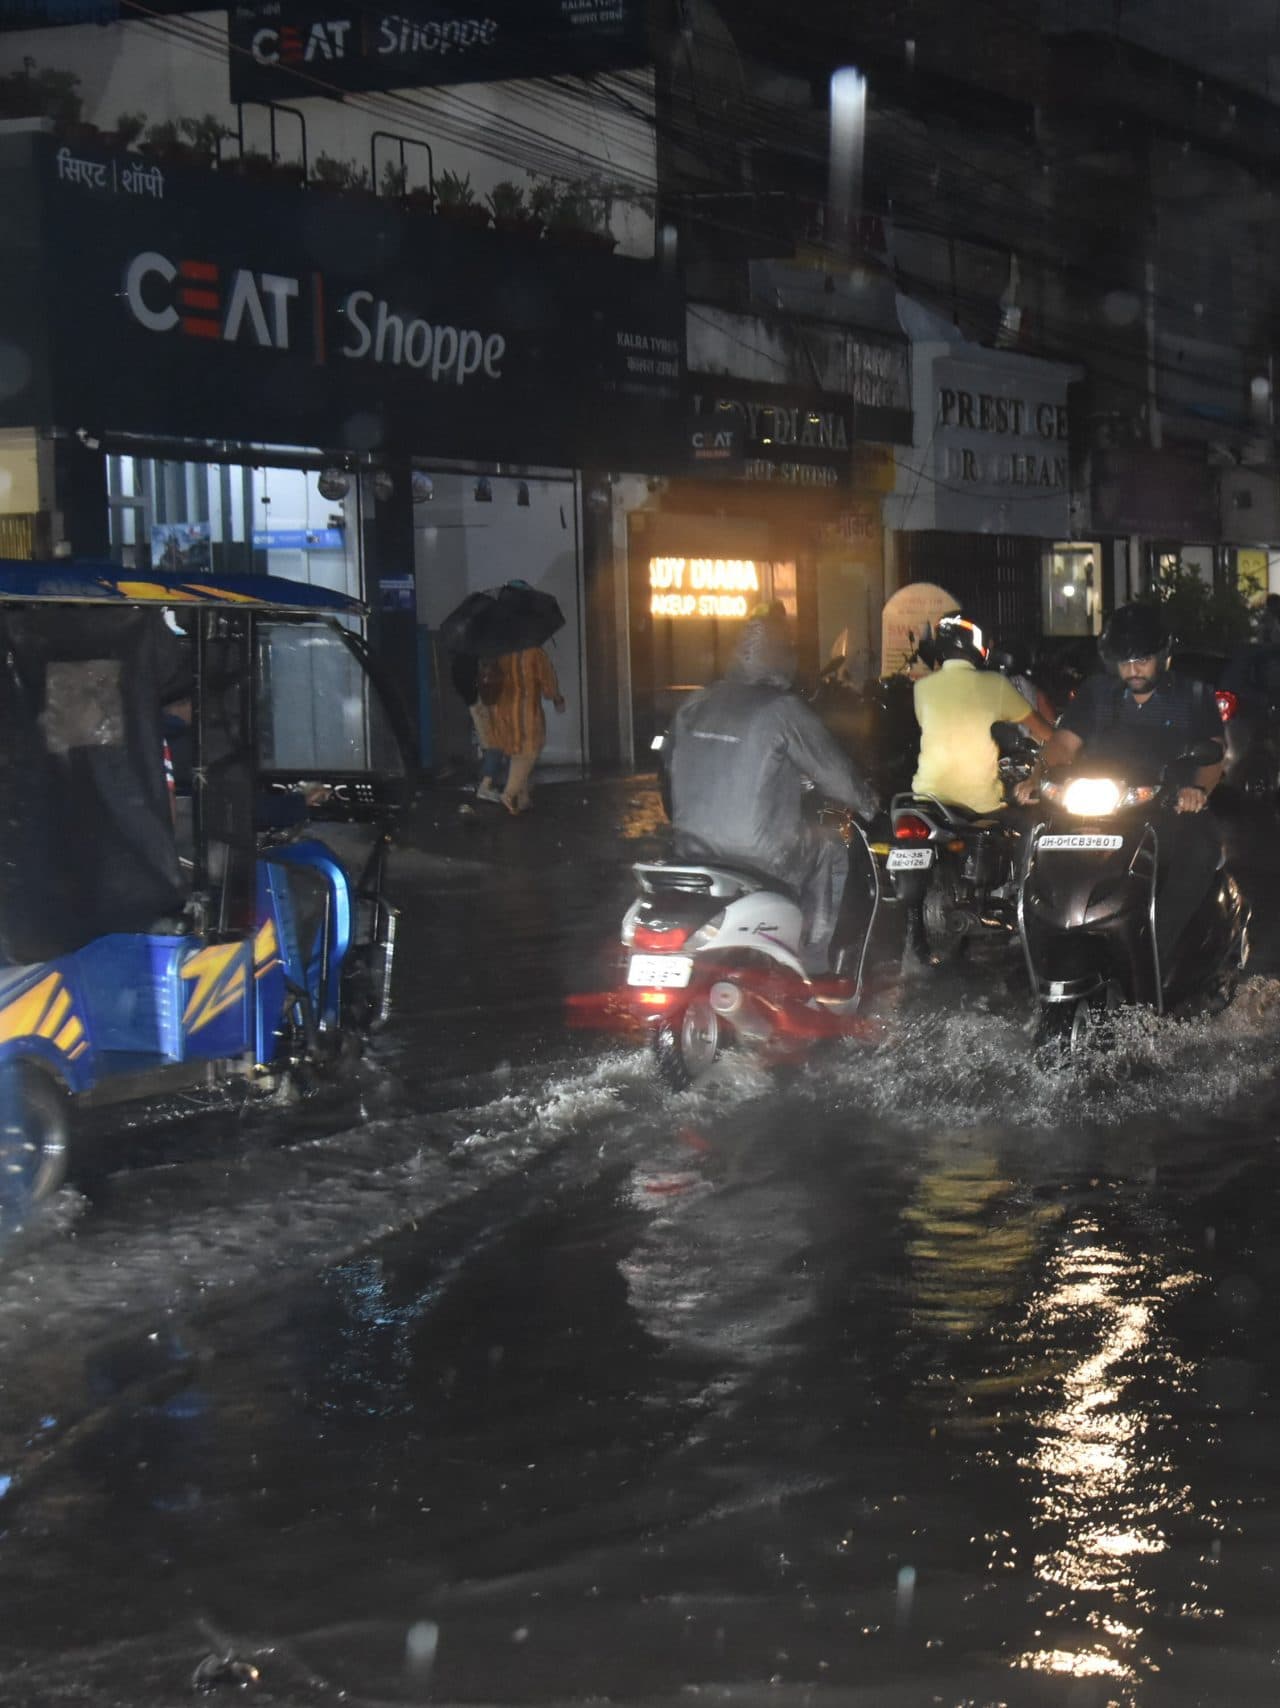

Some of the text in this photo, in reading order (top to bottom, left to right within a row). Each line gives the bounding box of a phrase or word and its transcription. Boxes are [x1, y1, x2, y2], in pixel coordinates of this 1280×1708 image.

[252, 15, 500, 64] CEAT Shoppe
[56, 146, 165, 199] सिएट शॉपी
[127, 251, 506, 385] CEAT Shoppe
